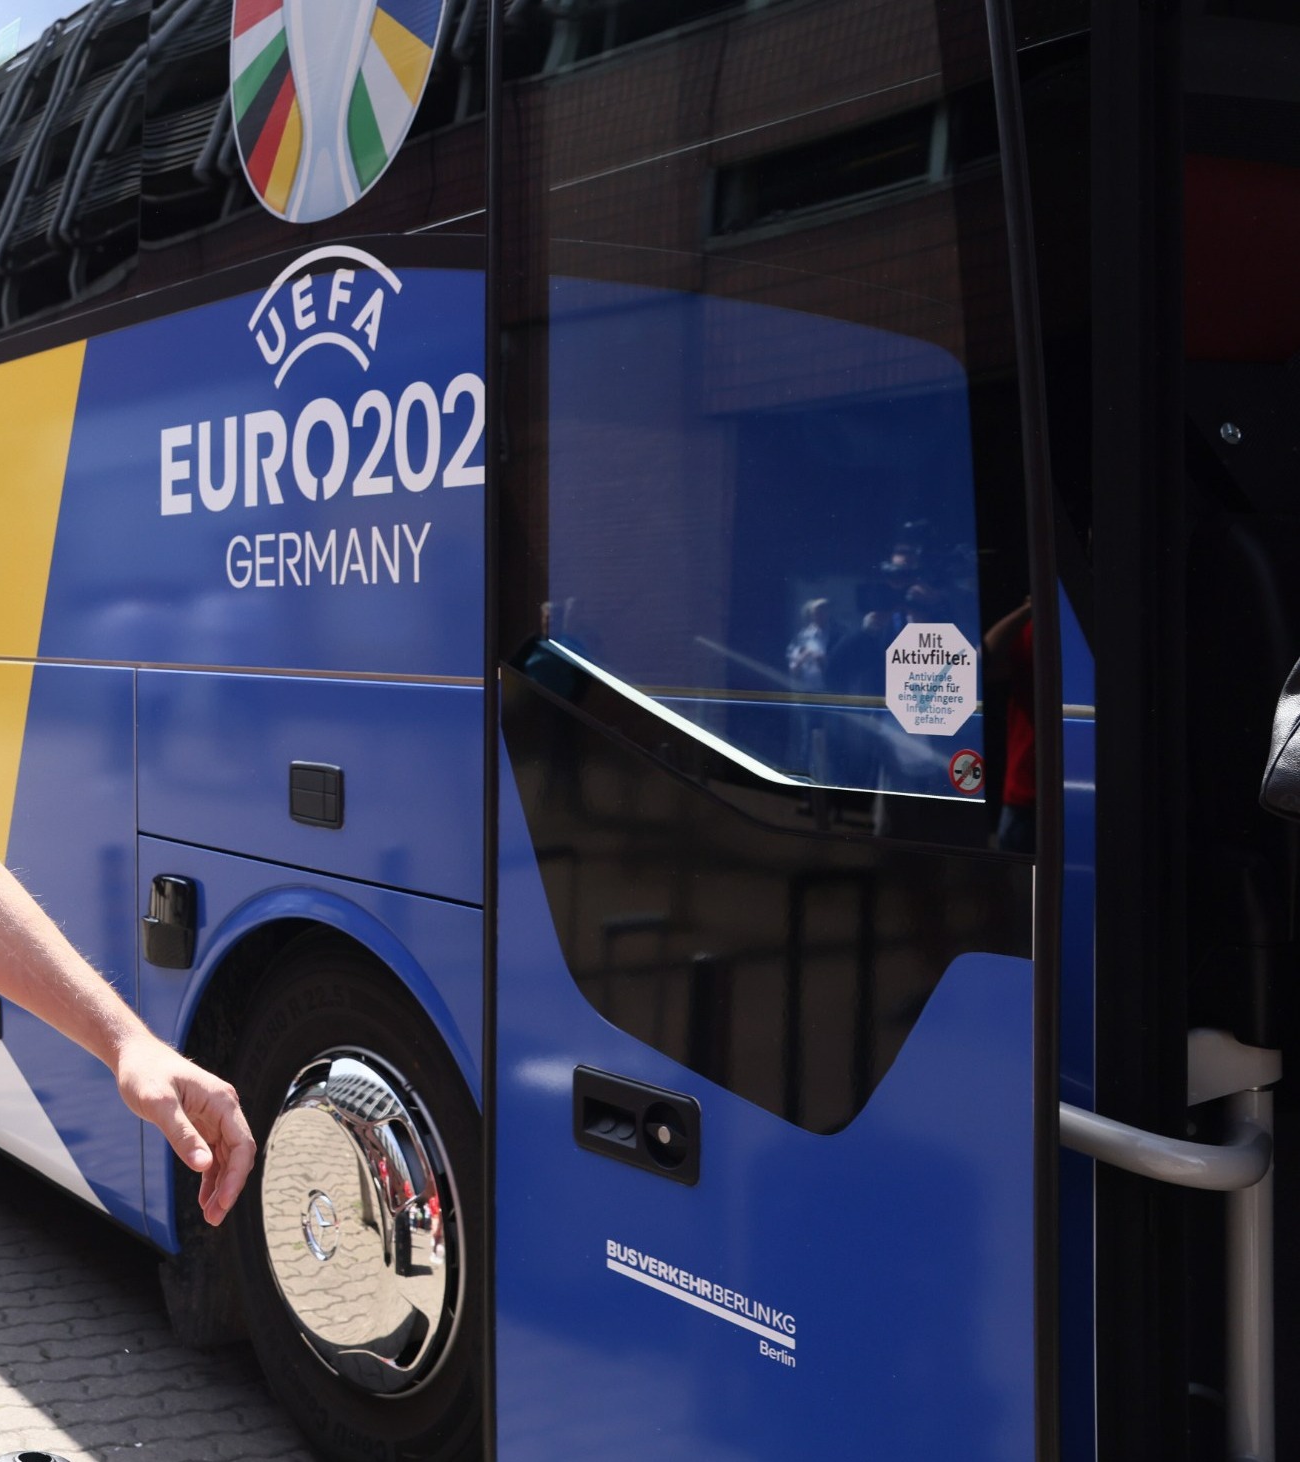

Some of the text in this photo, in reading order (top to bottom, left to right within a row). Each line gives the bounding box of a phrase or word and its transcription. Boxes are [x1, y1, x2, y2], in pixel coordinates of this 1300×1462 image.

[255, 268, 385, 365] UEFA
[226, 522, 432, 588] GERMANY
[918, 633, 943, 648] Mit
[891, 649, 971, 666] Aktivfilter.
[908, 672, 953, 682] Antivirale
[904, 682, 960, 693] Funktion für
[898, 692, 964, 705] eine geringere
[914, 714, 947, 725] gefahr.
[759, 1339, 796, 1368] Berlin
